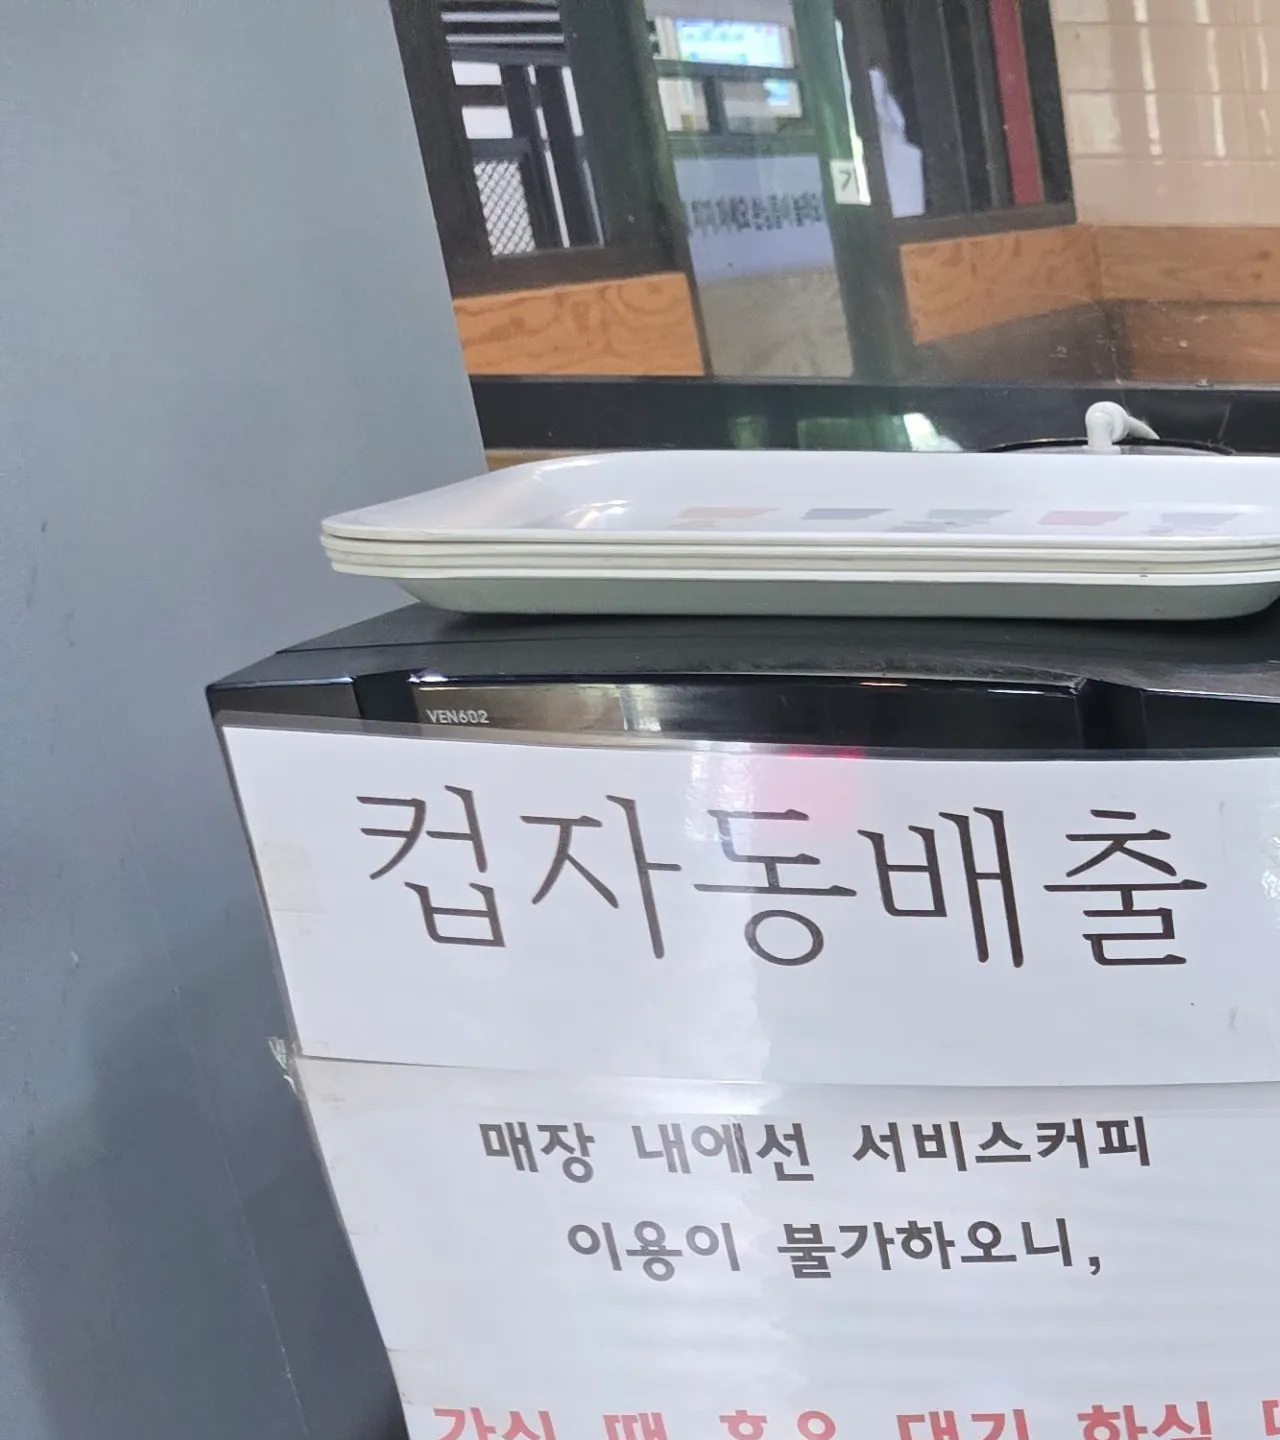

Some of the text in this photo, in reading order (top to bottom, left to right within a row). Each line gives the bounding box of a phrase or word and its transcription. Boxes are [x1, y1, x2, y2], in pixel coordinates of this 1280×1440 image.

[425, 708, 491, 724] VEN602
[356, 784, 1210, 971] 컵자동배출
[479, 1115, 1152, 1185] 매장 내에선 서비스커피
[567, 1217, 1103, 1283] 이용이 불가하오니,
